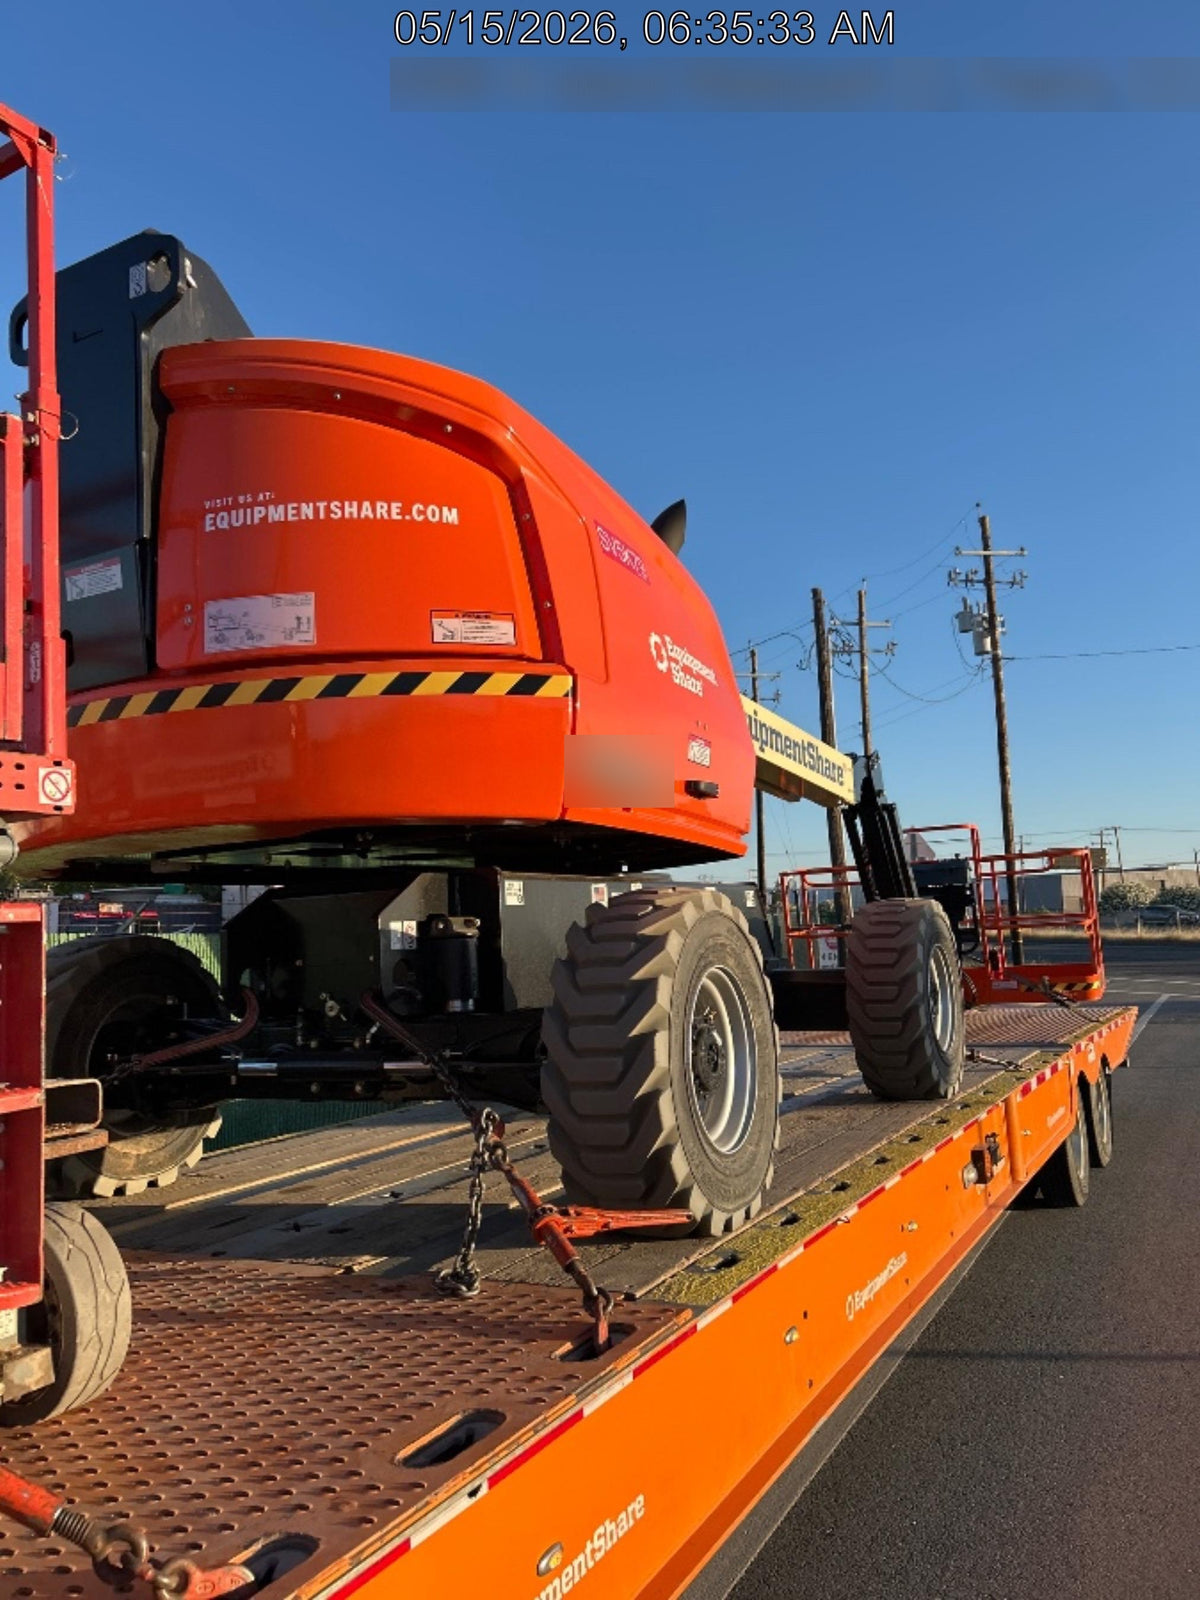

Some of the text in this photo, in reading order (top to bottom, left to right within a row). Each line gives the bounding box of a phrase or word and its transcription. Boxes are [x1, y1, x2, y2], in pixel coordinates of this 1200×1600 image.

[204, 496, 233, 509] VISIT
[238, 493, 252, 504] US
[205, 501, 459, 532] EQUIPMENTSHARE.COM
